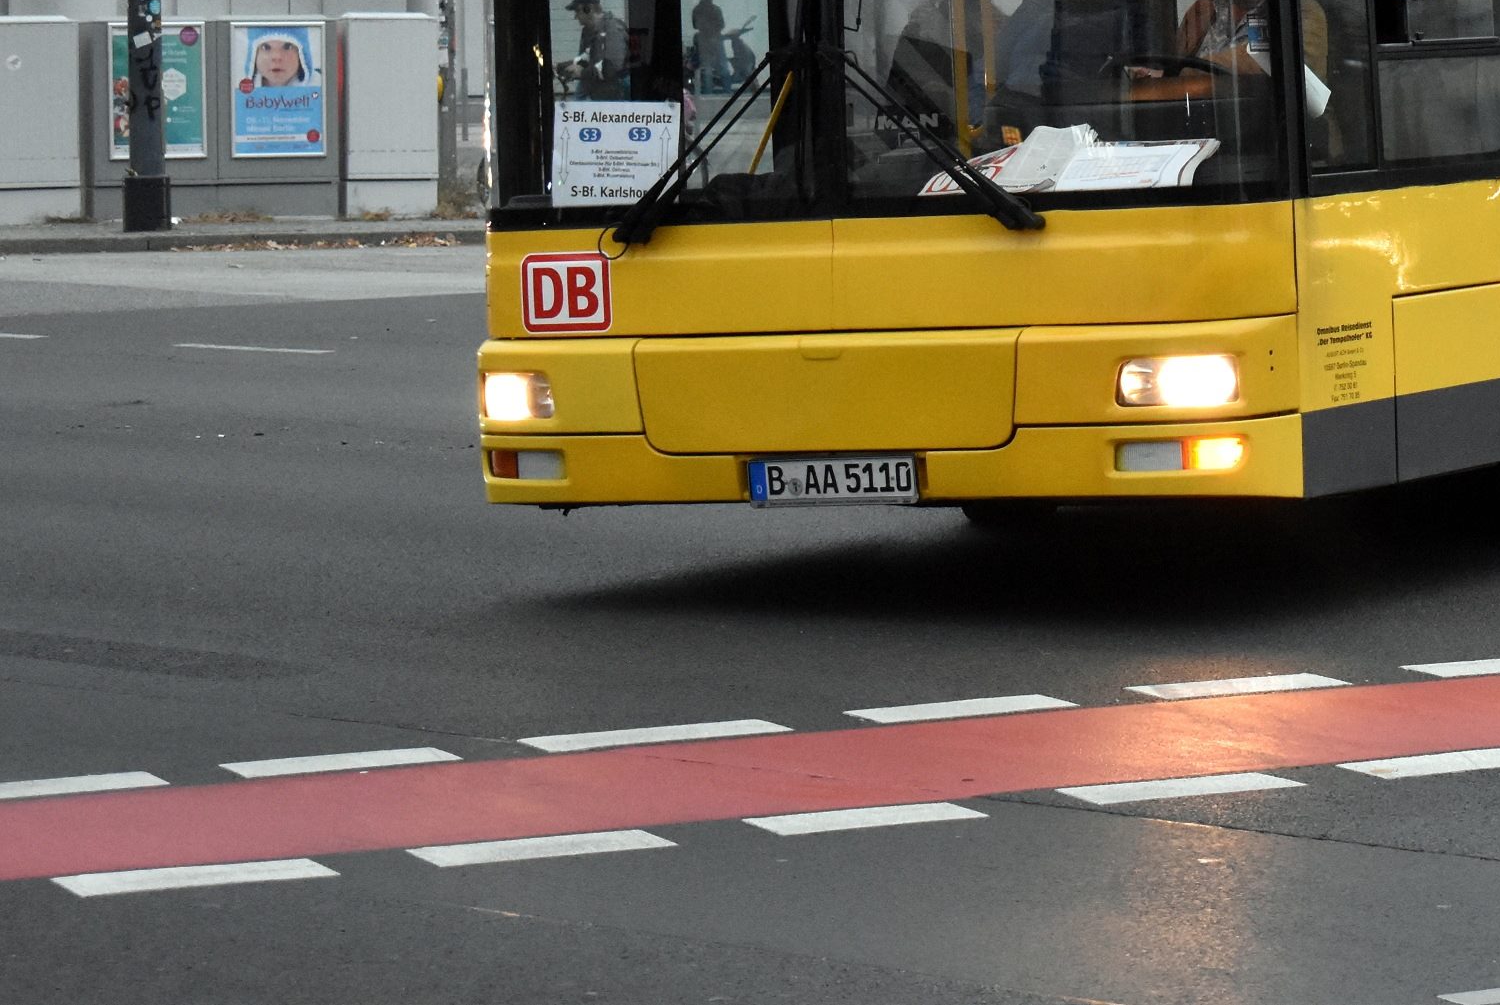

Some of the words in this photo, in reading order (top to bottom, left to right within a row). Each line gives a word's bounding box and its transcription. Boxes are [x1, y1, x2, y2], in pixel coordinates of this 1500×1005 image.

[562, 111, 587, 123] S-Bf.
[590, 111, 672, 126] Alexanderplatz
[877, 113, 939, 130] MAN
[583, 128, 598, 141] S3
[632, 127, 647, 140] S3
[570, 186, 597, 198] S-Bf.
[533, 267, 599, 319] DB
[768, 466, 785, 495] B
[805, 464, 839, 494] AA
[844, 462, 911, 493] 5110
